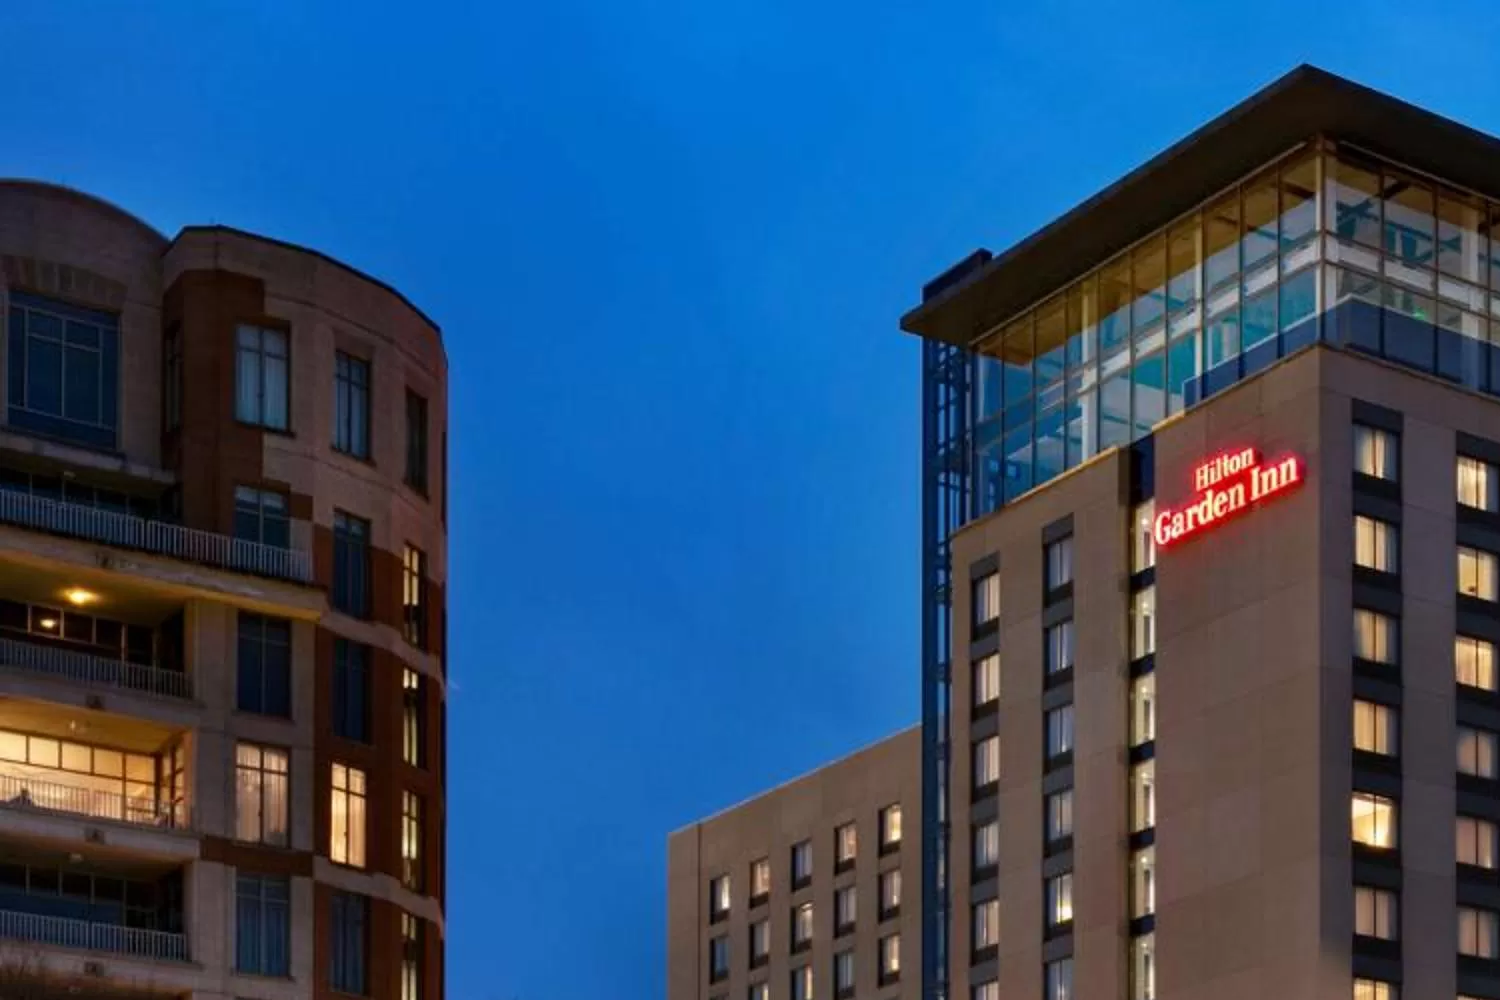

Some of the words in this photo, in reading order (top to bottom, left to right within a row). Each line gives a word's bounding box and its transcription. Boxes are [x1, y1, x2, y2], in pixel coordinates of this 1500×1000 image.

[1154, 483, 1246, 546] Garden
[1251, 457, 1299, 501] Inn
[1195, 447, 1255, 491] Hilton
